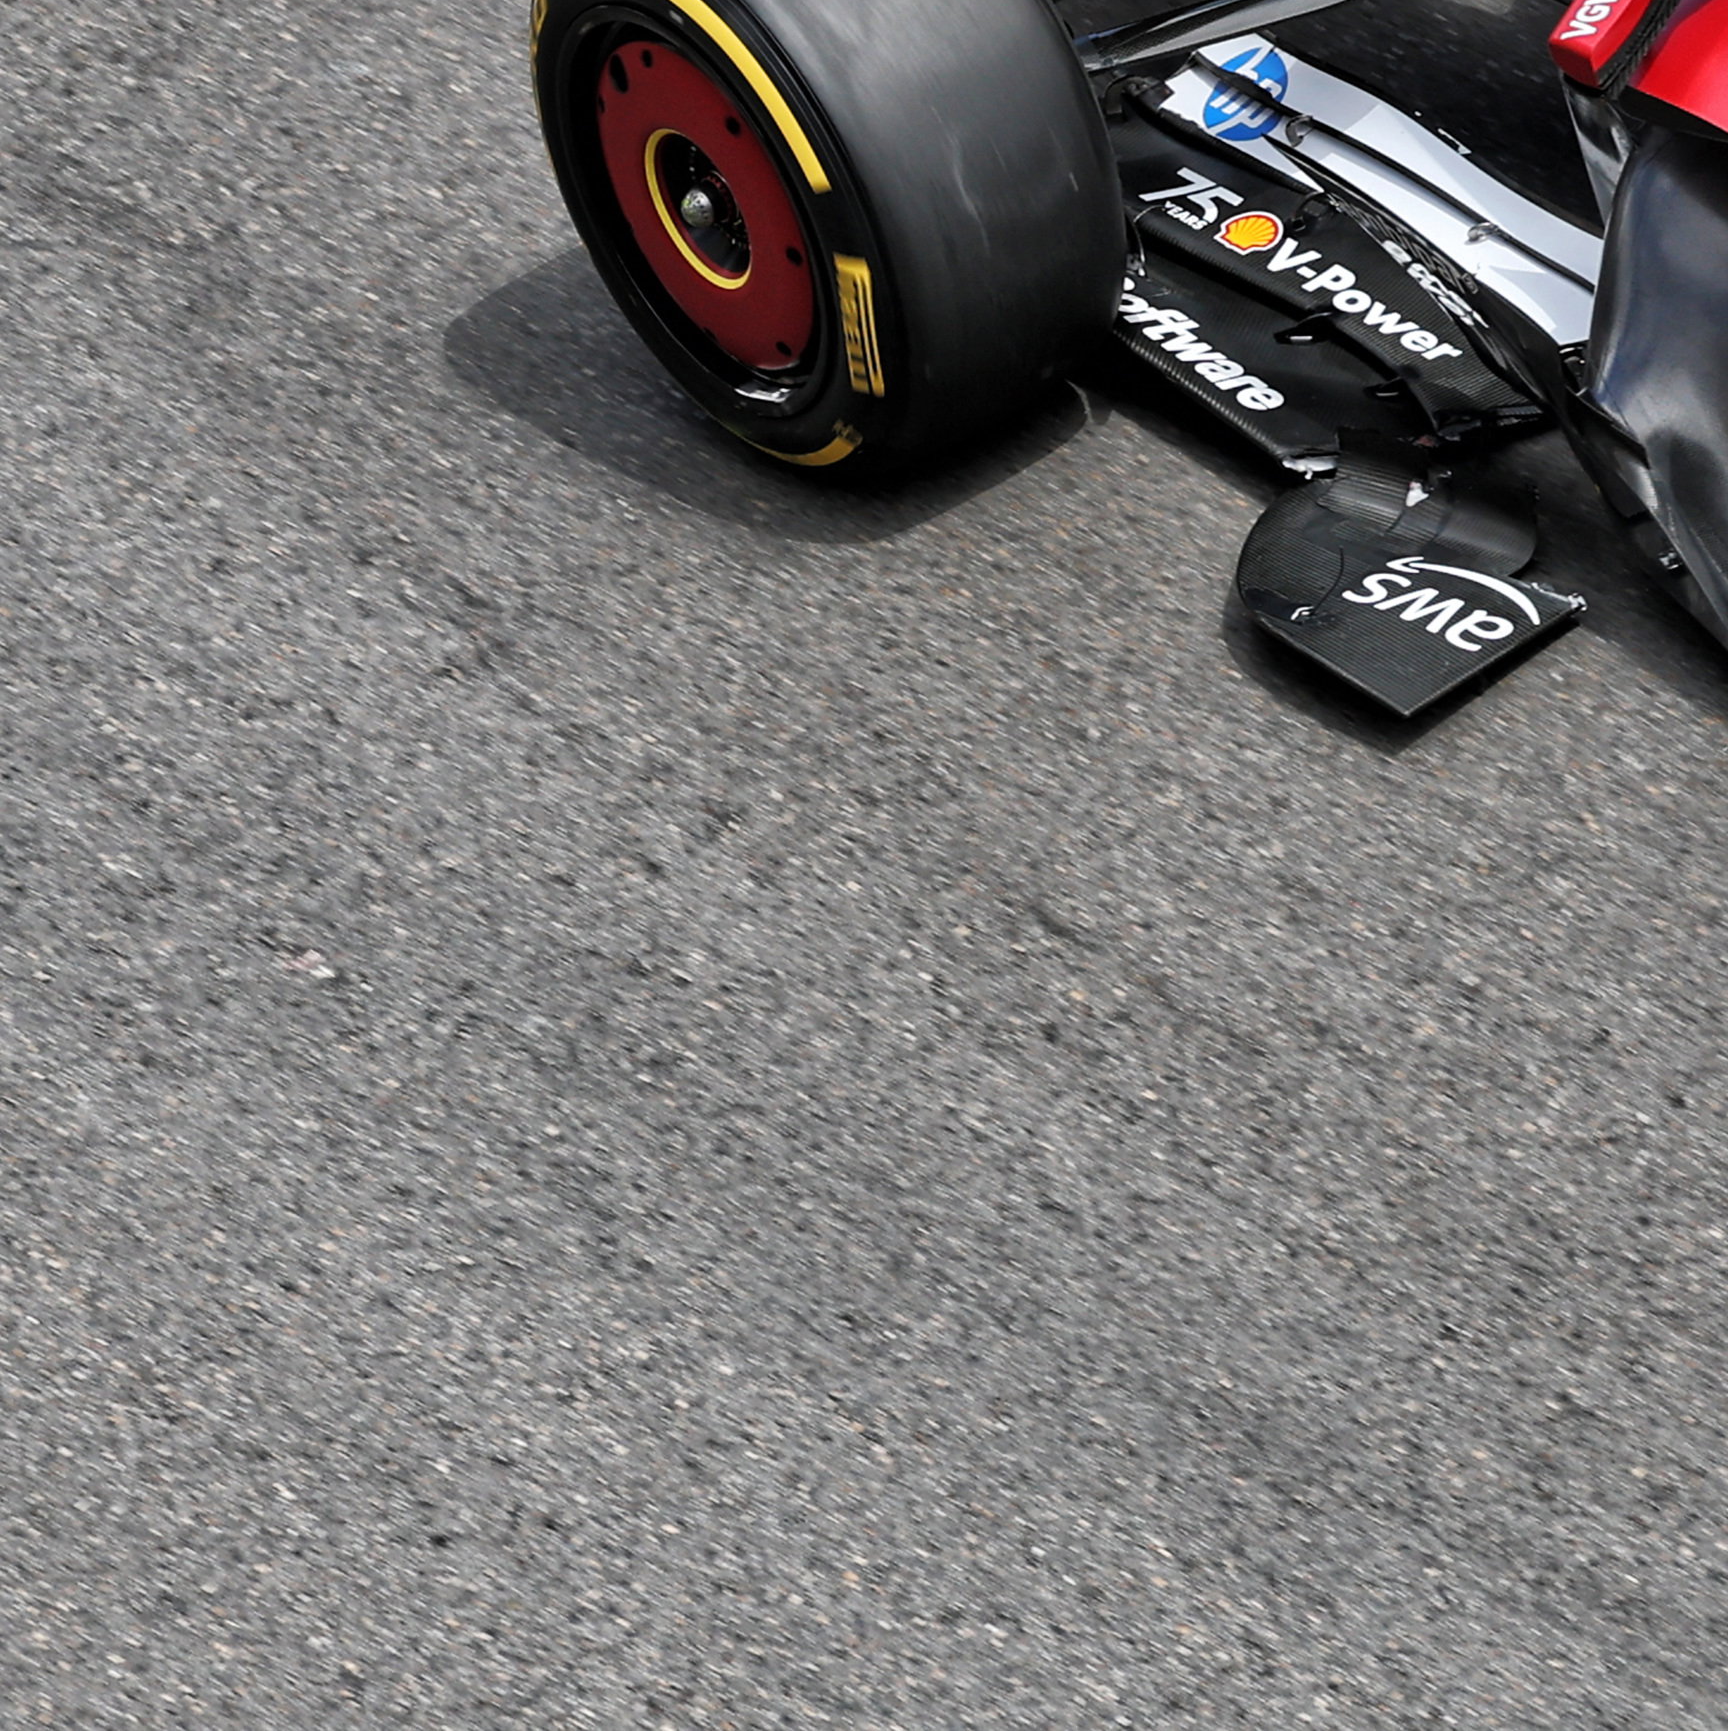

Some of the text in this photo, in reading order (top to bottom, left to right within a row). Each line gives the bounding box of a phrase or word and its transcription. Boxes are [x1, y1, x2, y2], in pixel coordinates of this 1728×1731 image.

[1138, 167, 1245, 224] 75
[1162, 200, 1208, 231] YEARS
[1266, 237, 1464, 362] V-Power
[1118, 277, 1284, 410] oftware
[1342, 571, 1514, 652] aws
